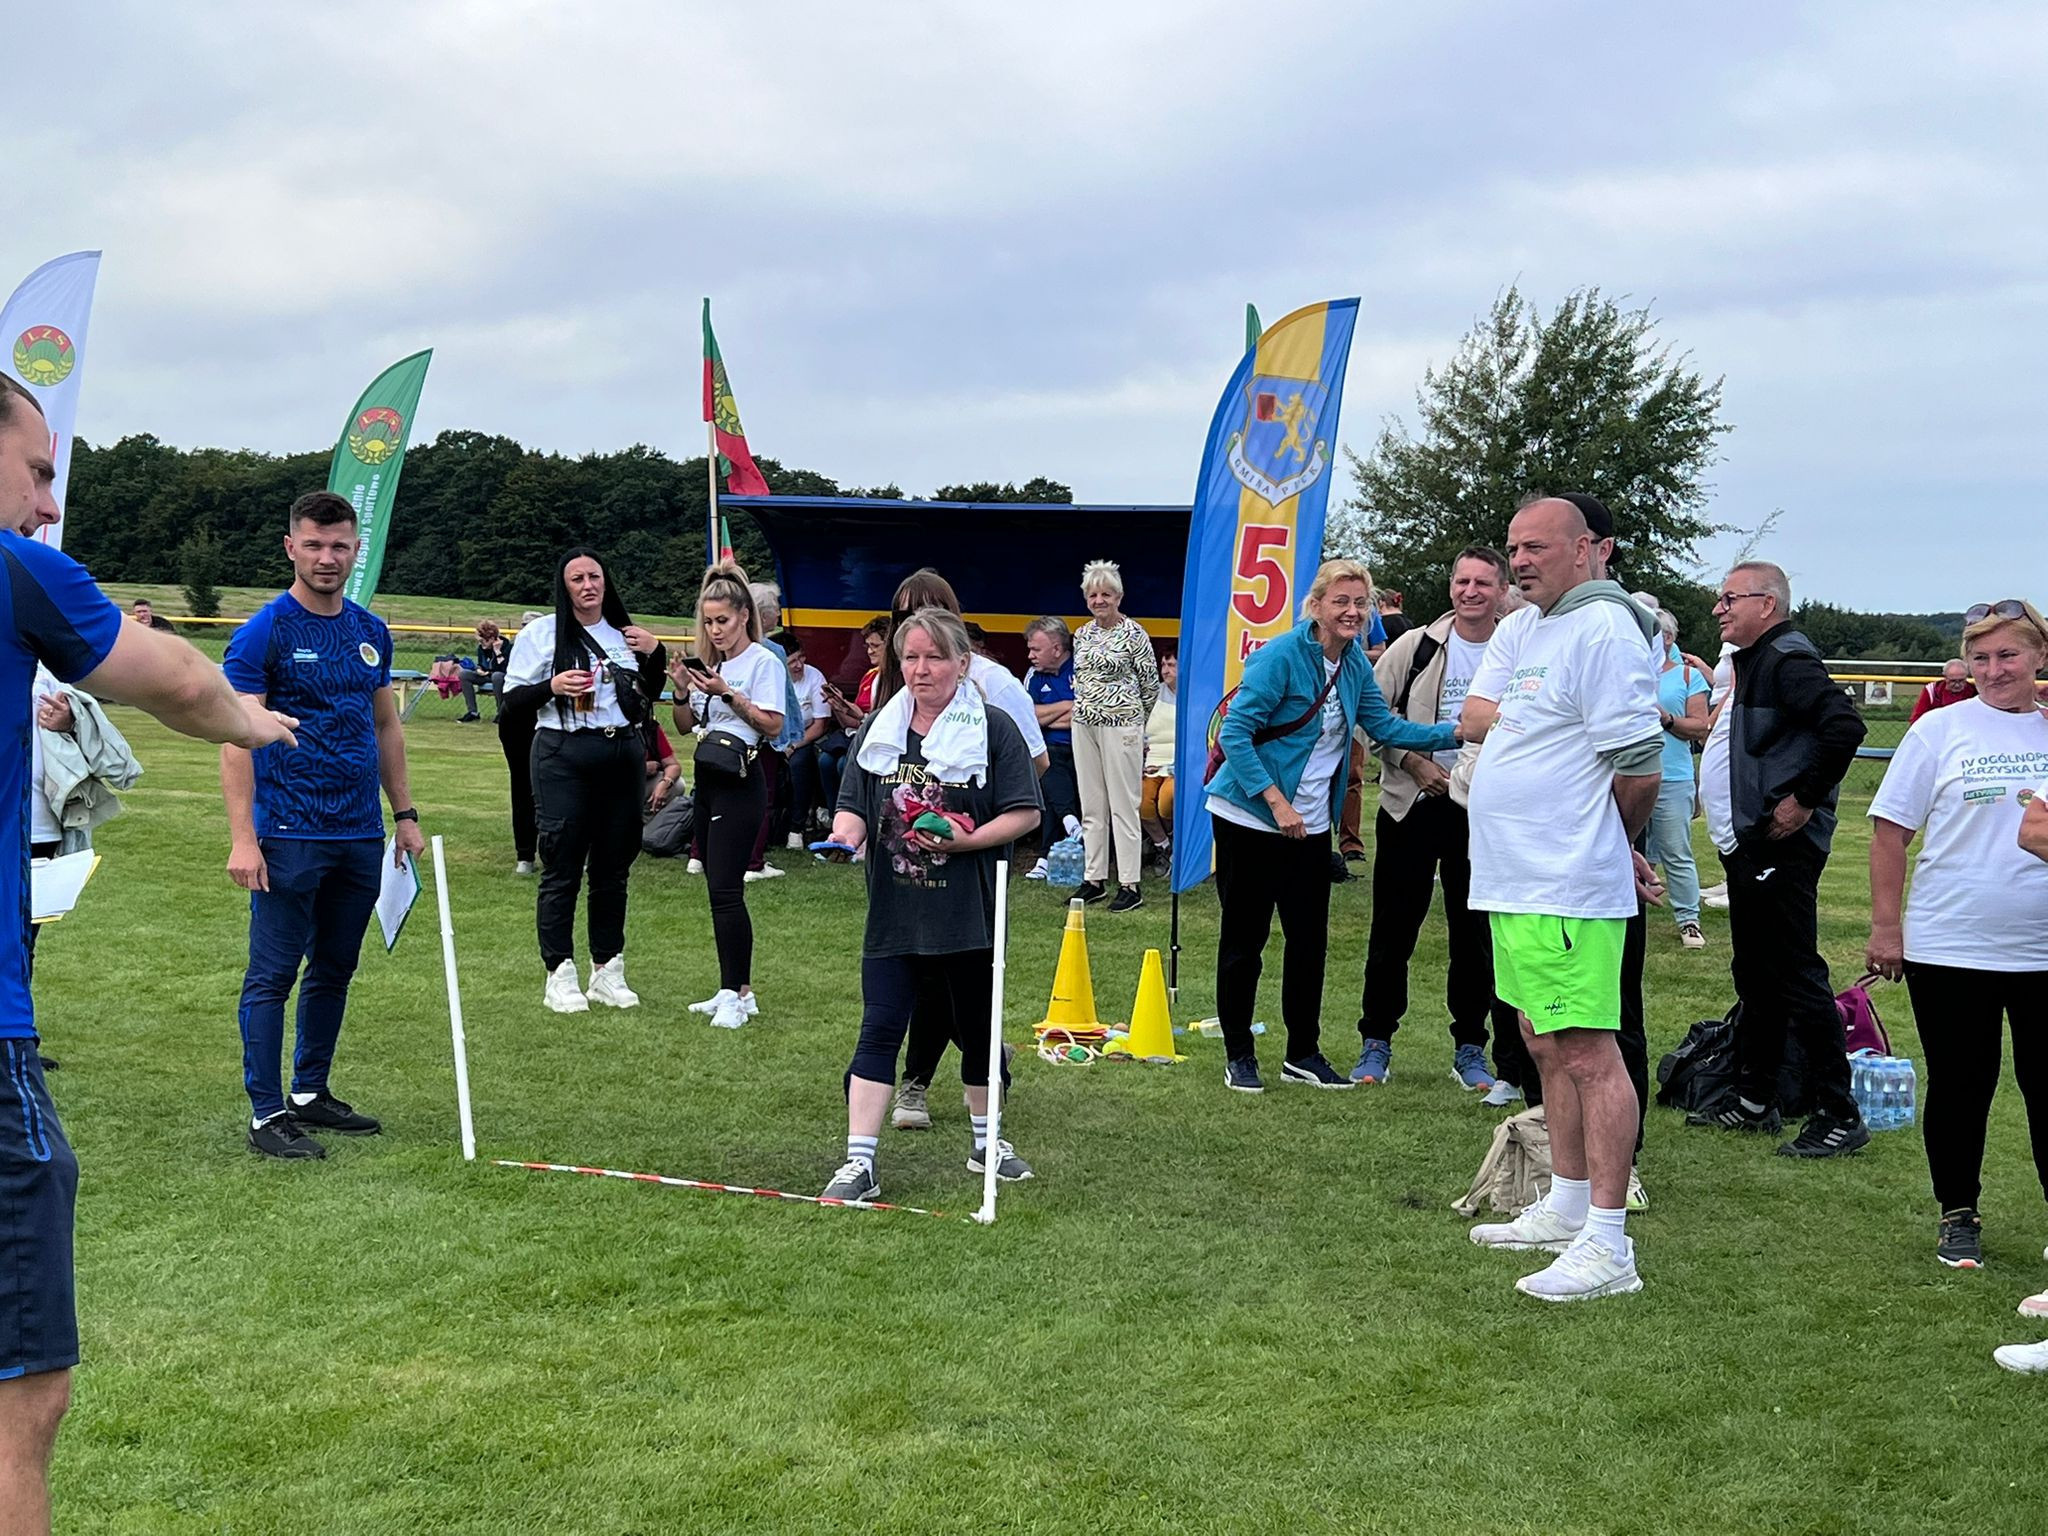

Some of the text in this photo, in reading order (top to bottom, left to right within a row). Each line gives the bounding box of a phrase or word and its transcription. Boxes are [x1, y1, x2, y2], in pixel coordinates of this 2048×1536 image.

[26, 328, 66, 346] LZS
[361, 411, 399, 425] LZS
[1233, 458, 1319, 496] GMINA PUCK
[1231, 524, 1290, 627] 5
[1961, 758, 1975, 769] IV
[1962, 764, 2032, 778] IGRZYSKA
